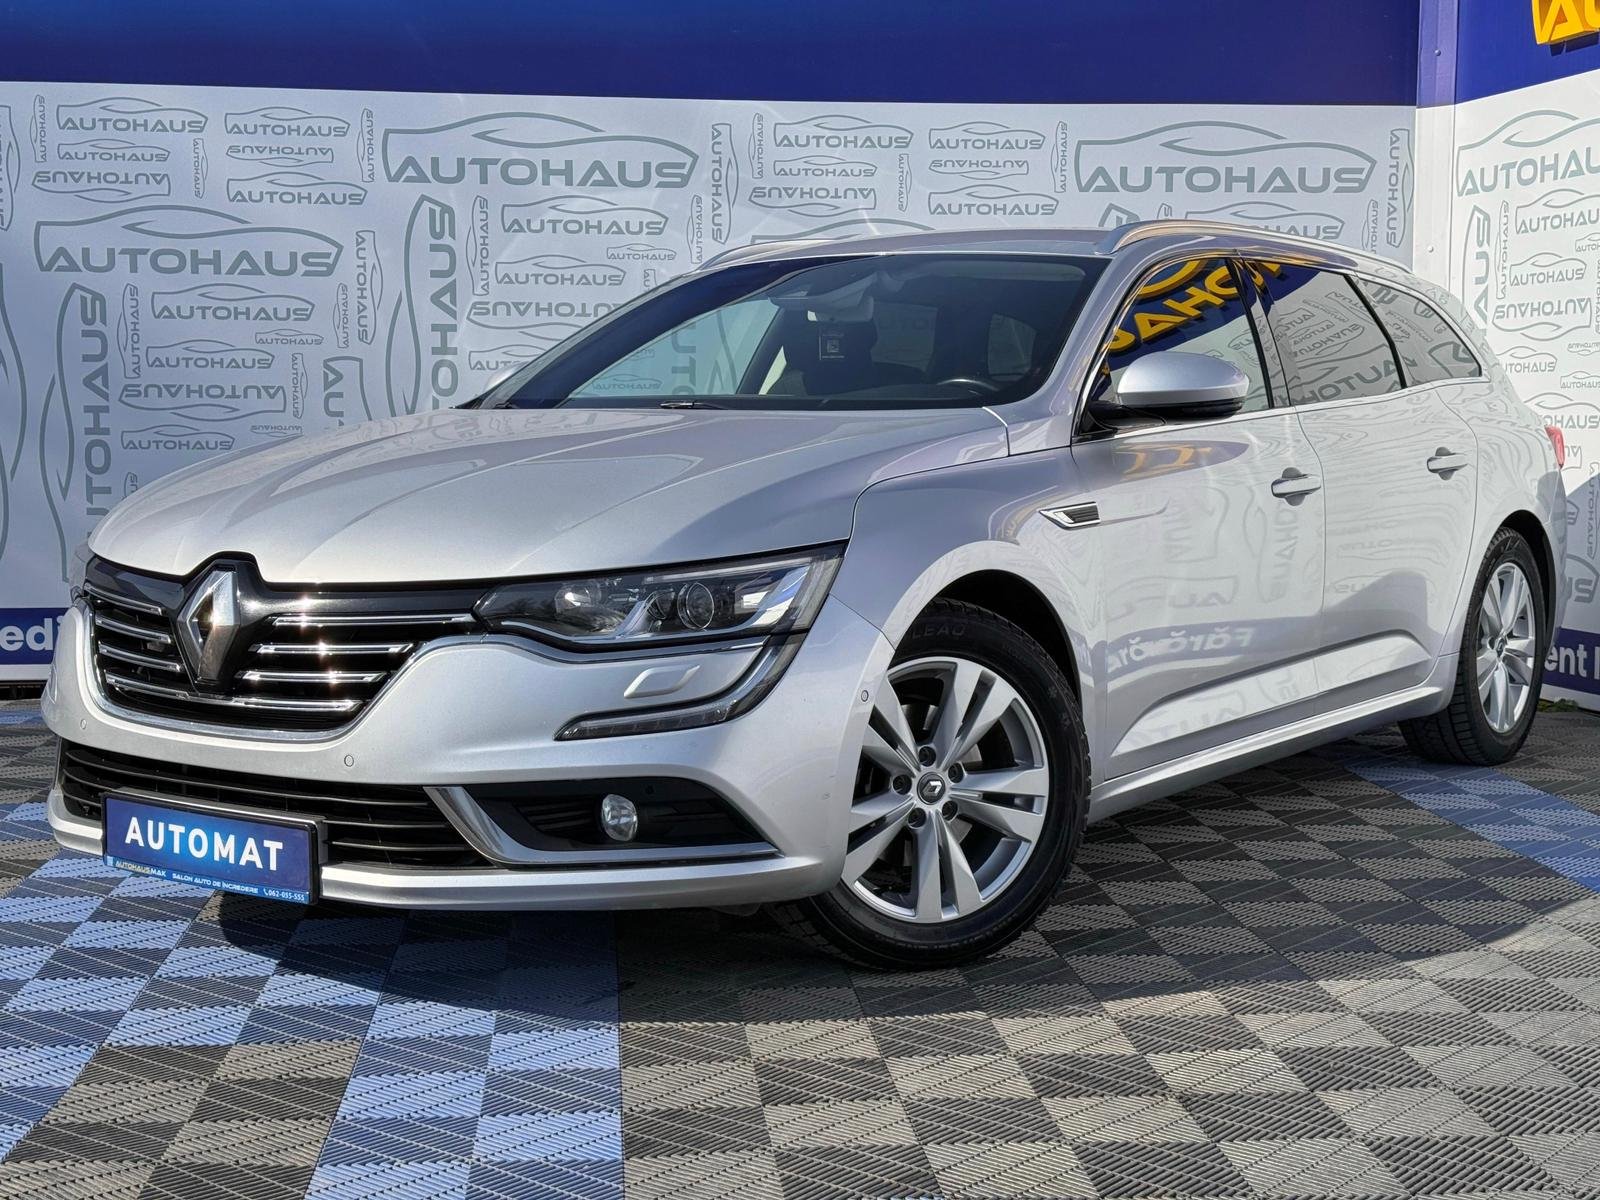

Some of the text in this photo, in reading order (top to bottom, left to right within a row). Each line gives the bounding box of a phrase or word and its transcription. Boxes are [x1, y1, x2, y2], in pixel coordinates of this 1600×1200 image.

[39, 95, 47, 162] AUTOHAUS
[59, 117, 206, 133] AUTOHAUS
[228, 124, 349, 137] AUTOHAUS
[366, 109, 374, 182] AUTOHAUS
[775, 134, 912, 149] AUTOHAUS
[930, 138, 1044, 150] AUTOHAUS
[59, 151, 169, 162] AUTOHAUS
[229, 145, 331, 156] AUTOHAUS
[1059, 122, 1067, 192] AUTOHAUS
[35, 171, 168, 185] AUTOHAUS
[388, 156, 696, 188] AUTOHAUS
[775, 167, 877, 177] AUTOHAUS
[1079, 166, 1374, 194] AUTOHAUS
[712, 124, 724, 244] AUTOHAUS
[1388, 130, 1399, 248] AUTOHAUS
[231, 190, 366, 205] AUTOHAUS
[752, 187, 874, 199] AUTOHAUS
[931, 202, 1058, 216] AUTOHAUS
[503, 218, 667, 236] AUTOHAUS
[480, 197, 489, 296] AUTOHAUS
[41, 246, 341, 277] AUTOHAUS
[608, 252, 676, 261] AUTOHAUS
[498, 273, 625, 286] AUTOHAUS
[1510, 267, 1586, 286] AUTOHAUS
[355, 231, 372, 344] AUTOHAUS
[153, 304, 314, 321] AUTOHAUS
[428, 206, 459, 409] OHAUS
[472, 301, 622, 318] UTOHAUS
[1495, 298, 1591, 320] AUTOHAUS
[339, 285, 349, 348] AUTOHAUS
[129, 284, 141, 379] AUTOHAUS
[256, 336, 323, 346] AUTOHAUS
[148, 356, 274, 369] AUTOHAUS
[1505, 362, 1556, 373] TOHAUS
[122, 383, 284, 400] AUTOHAUS
[291, 353, 299, 418] AUTOHAUS
[79, 294, 112, 518] TOHAUS
[123, 439, 235, 451] AUTOHAUS
[125, 816, 284, 871] AUTOMAT
[172, 873, 193, 882] SALON
[194, 877, 211, 886] AUTO
[212, 880, 221, 888] DE
